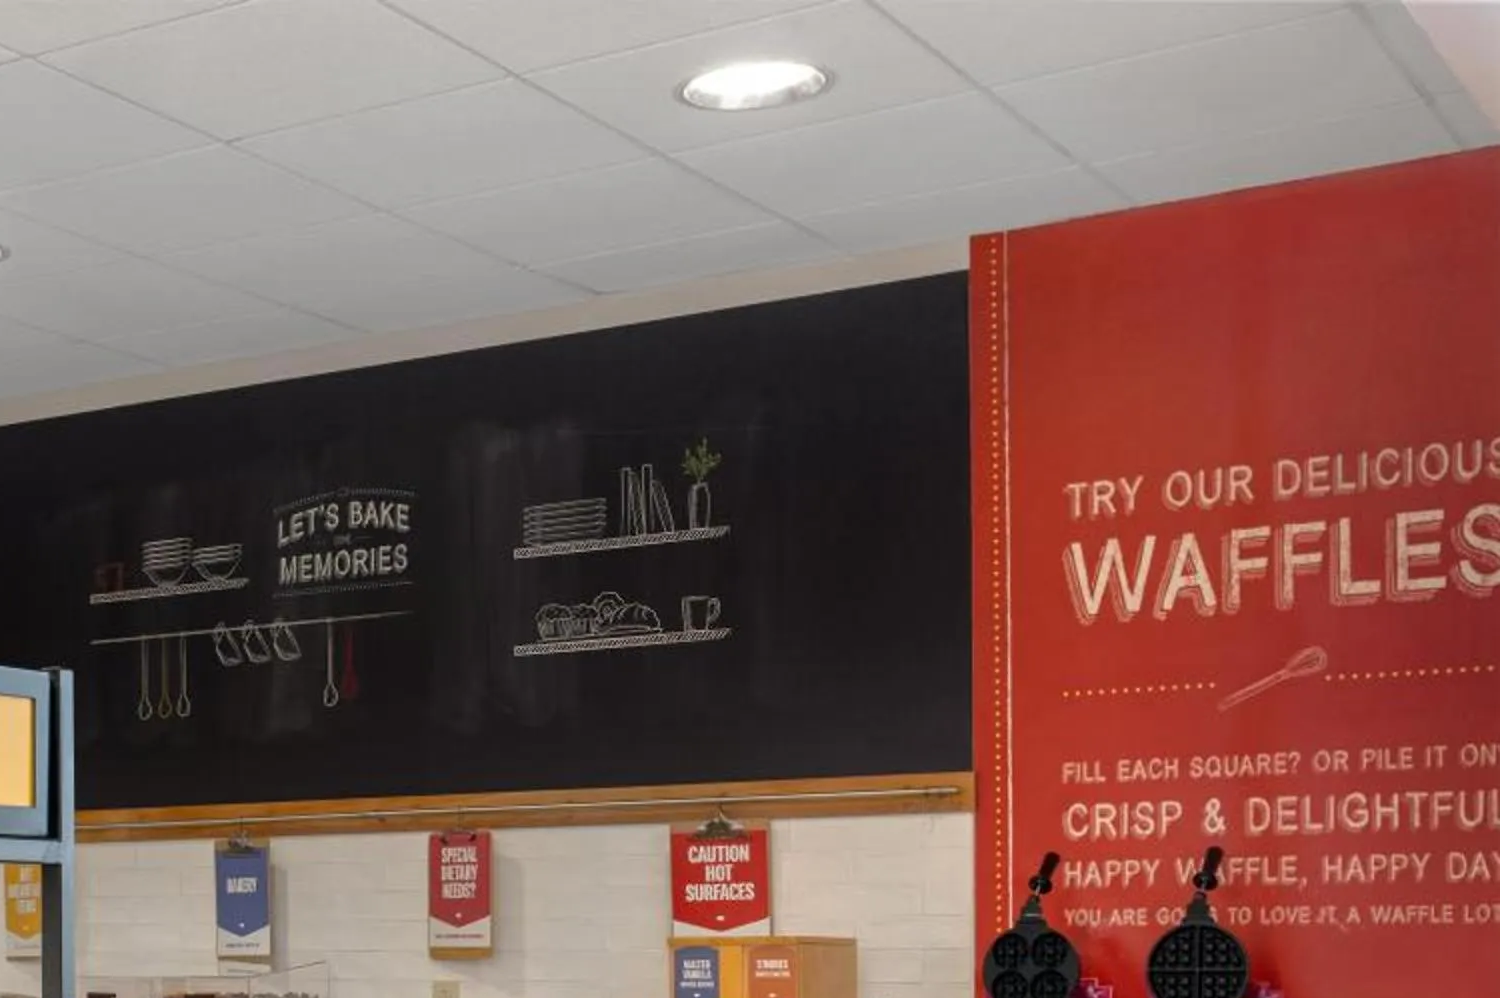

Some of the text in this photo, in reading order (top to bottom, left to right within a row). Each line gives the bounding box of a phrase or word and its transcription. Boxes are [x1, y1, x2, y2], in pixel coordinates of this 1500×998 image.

[1063, 437, 1500, 519] TRY OUR DELICIOUS
[277, 500, 410, 548] LET'S BAKE
[279, 543, 408, 585] MEMORIES
[1062, 504, 1500, 626] WAFFLES
[1062, 743, 1500, 784] FILL EACH SQUARE? OR PILE IT ON
[1062, 788, 1500, 842] CRISP & DELIGHTFUL
[687, 844, 750, 864] CAUTION
[704, 864, 734, 881] HOT
[1063, 858, 1160, 889] HAPPY
[1321, 852, 1431, 885] HAPPY
[685, 883, 755, 902] SURFACES
[1064, 908, 1101, 927] YOU
[1108, 907, 1148, 926] ARE
[1228, 906, 1252, 925] TO
[1260, 906, 1311, 925] LOVE
[1346, 906, 1361, 925] A
[1370, 904, 1454, 925] WAFFLE
